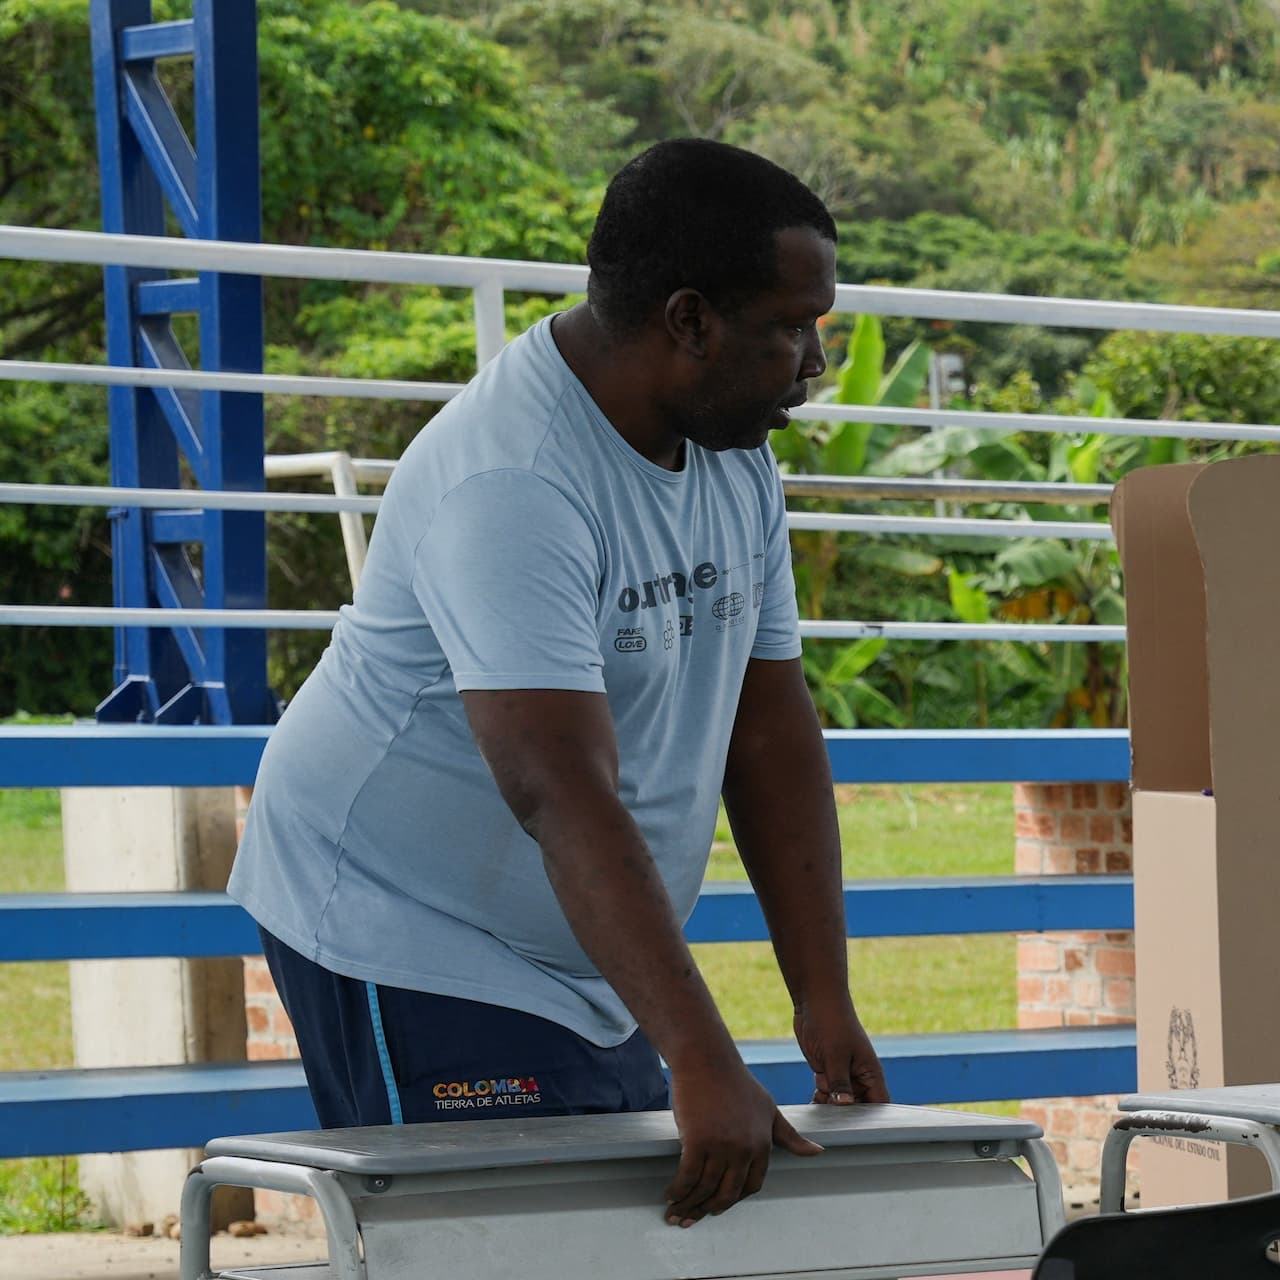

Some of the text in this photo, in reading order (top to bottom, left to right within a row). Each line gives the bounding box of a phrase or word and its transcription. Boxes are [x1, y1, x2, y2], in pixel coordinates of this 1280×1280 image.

[618, 639, 643, 649] LOVE
[433, 1077, 540, 1099] COLOMBIA
[435, 1093, 541, 1110] TIERRA DE ATLETAS
